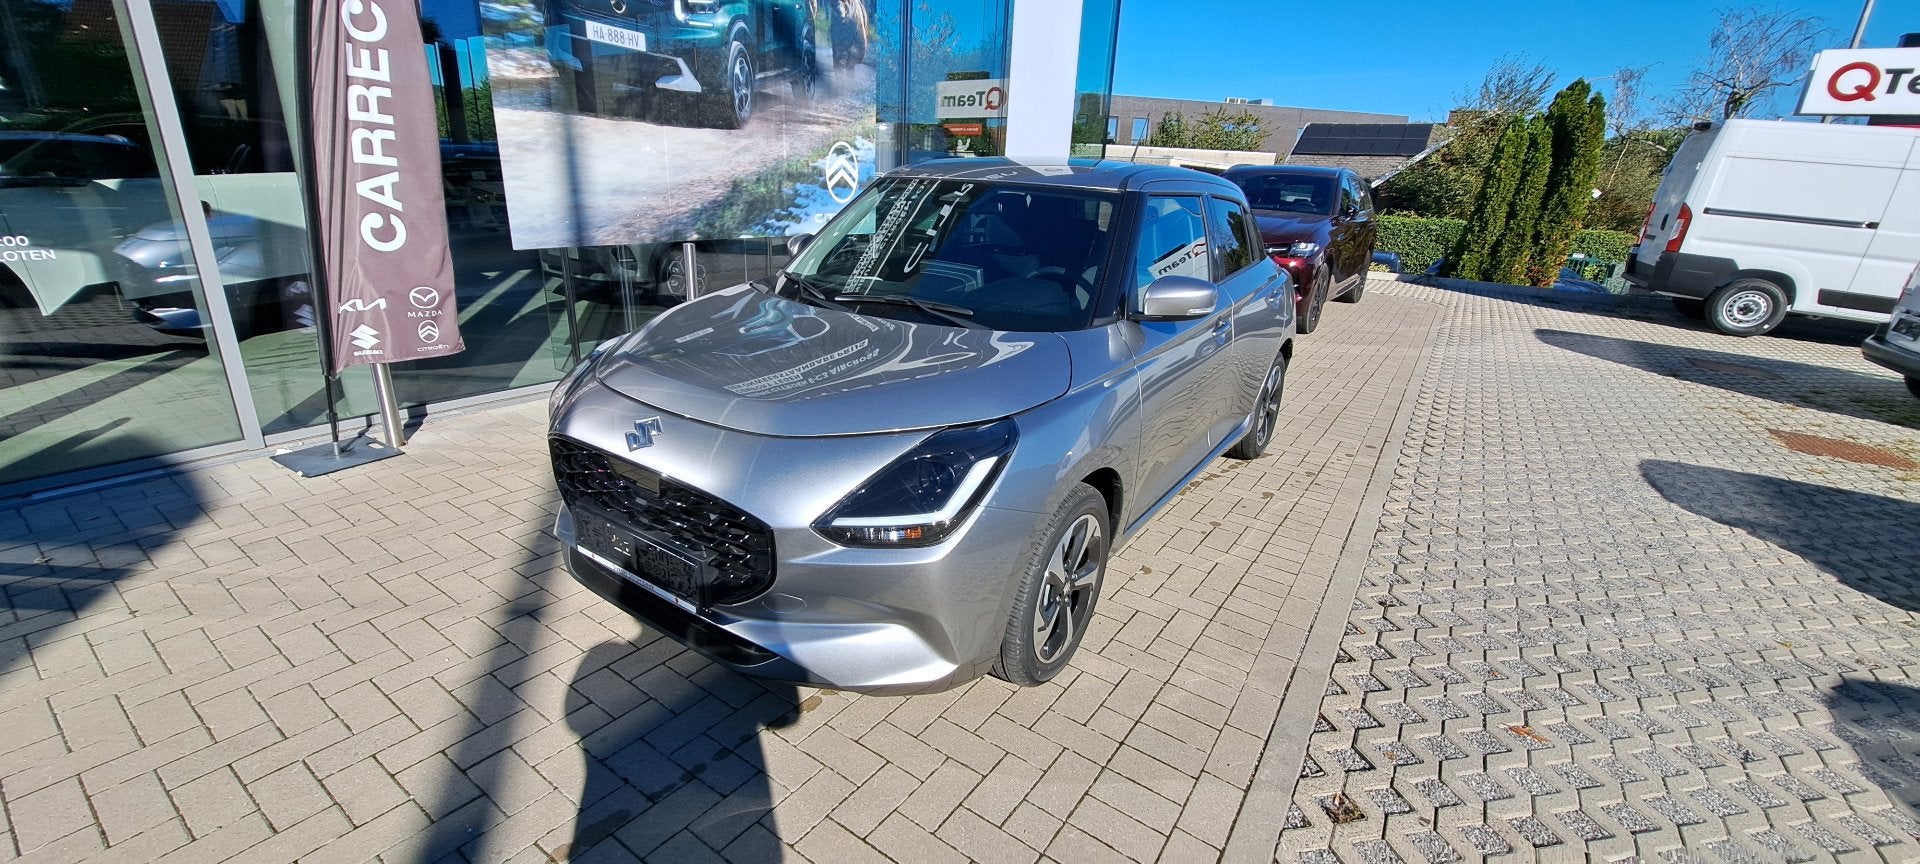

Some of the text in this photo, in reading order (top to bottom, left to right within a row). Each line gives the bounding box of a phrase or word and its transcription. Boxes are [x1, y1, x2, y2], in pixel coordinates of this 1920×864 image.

[592, 24, 639, 48] HA-888-HV
[341, 0, 407, 252] CARREC
[407, 310, 443, 318] MAZDA
